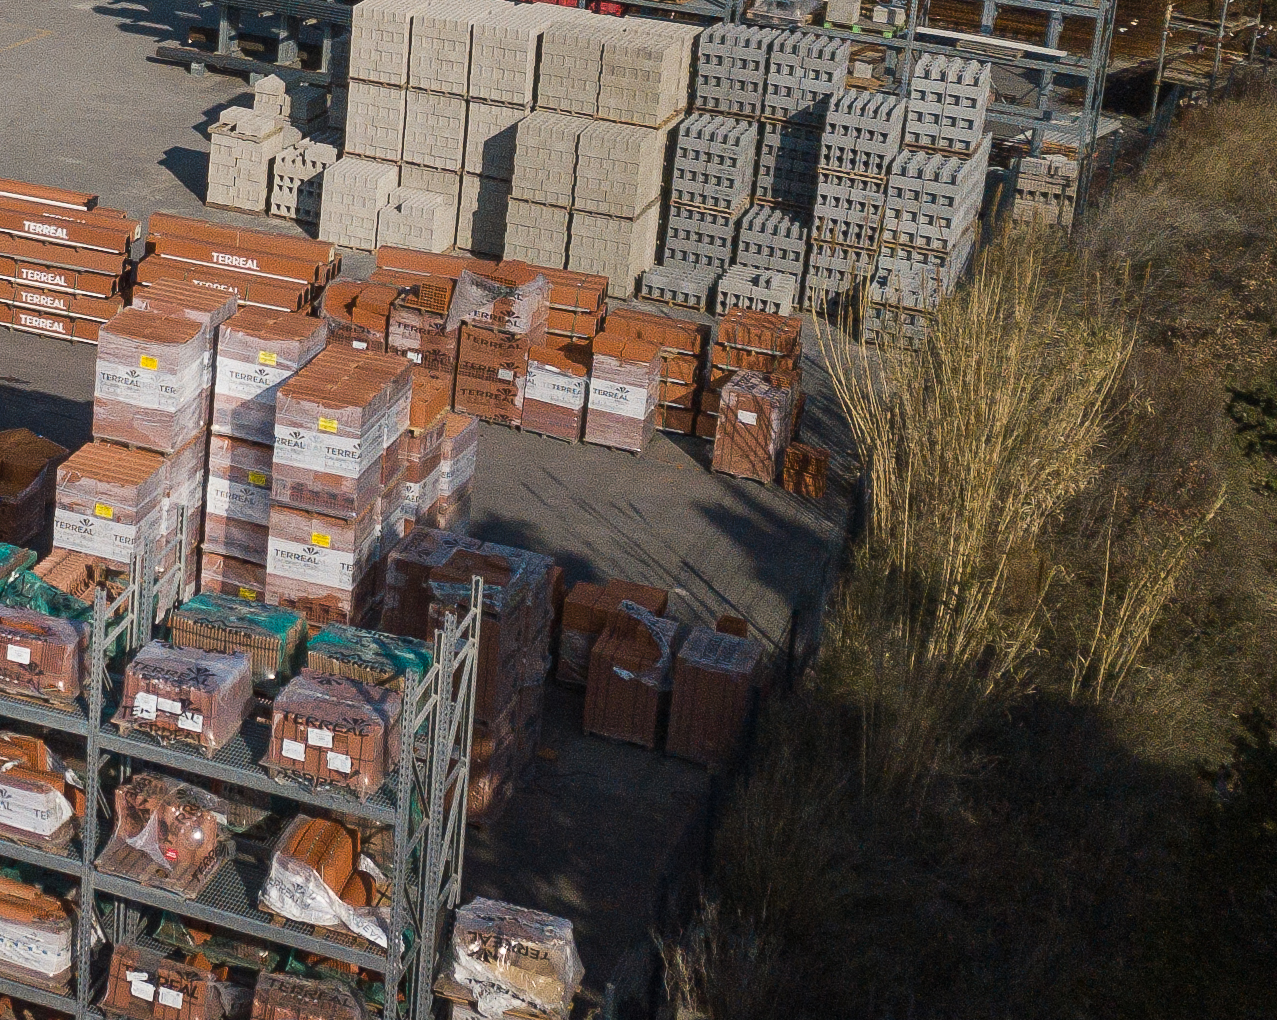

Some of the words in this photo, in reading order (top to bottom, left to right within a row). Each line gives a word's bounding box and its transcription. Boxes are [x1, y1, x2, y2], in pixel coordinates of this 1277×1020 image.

[23, 221, 69, 239] TERREAL
[211, 252, 260, 270] TERREAL
[21, 268, 67, 286] TERREAL
[21, 292, 66, 309] TERREAL
[20, 314, 65, 333] TERREAL
[465, 333, 523, 350] TERREAL
[100, 372, 141, 388] TERREAL
[229, 370, 271, 386] TERREAL
[460, 388, 517, 406] TERREAL
[593, 388, 629, 402] TERREAL
[275, 437, 306, 450] RREAL
[215, 489, 255, 505] TERREAL
[54, 520, 94, 536] TERREAL
[274, 549, 320, 565] TERREAL
